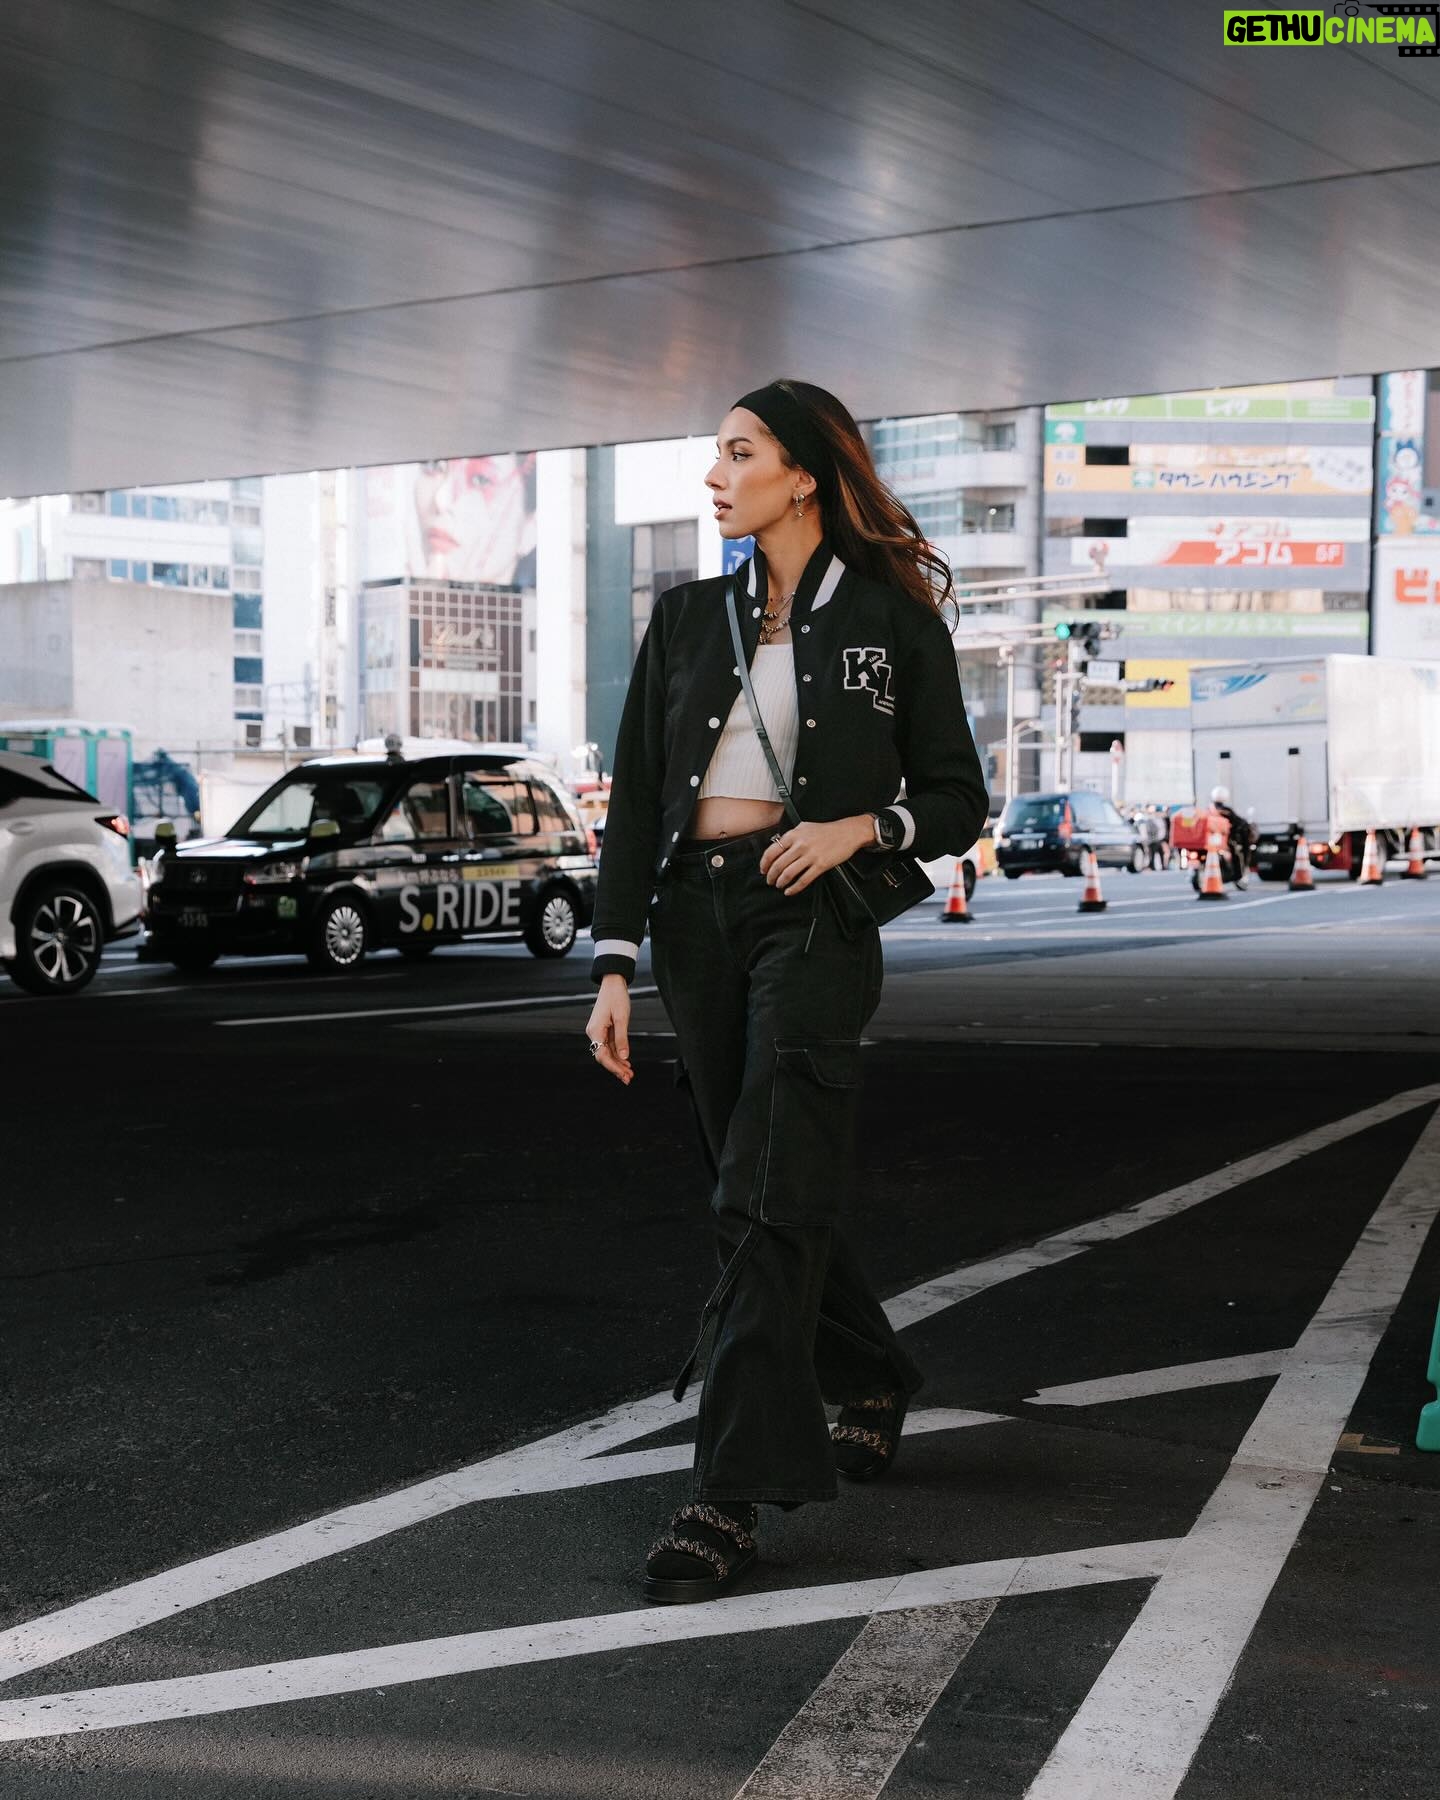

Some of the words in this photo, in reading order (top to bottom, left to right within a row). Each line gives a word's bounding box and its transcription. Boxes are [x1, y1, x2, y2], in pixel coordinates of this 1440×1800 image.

[1160, 470, 1297, 489] タウンハウジング
[1214, 541, 1293, 565] アコム
[399, 880, 521, 934] S.RIDE
